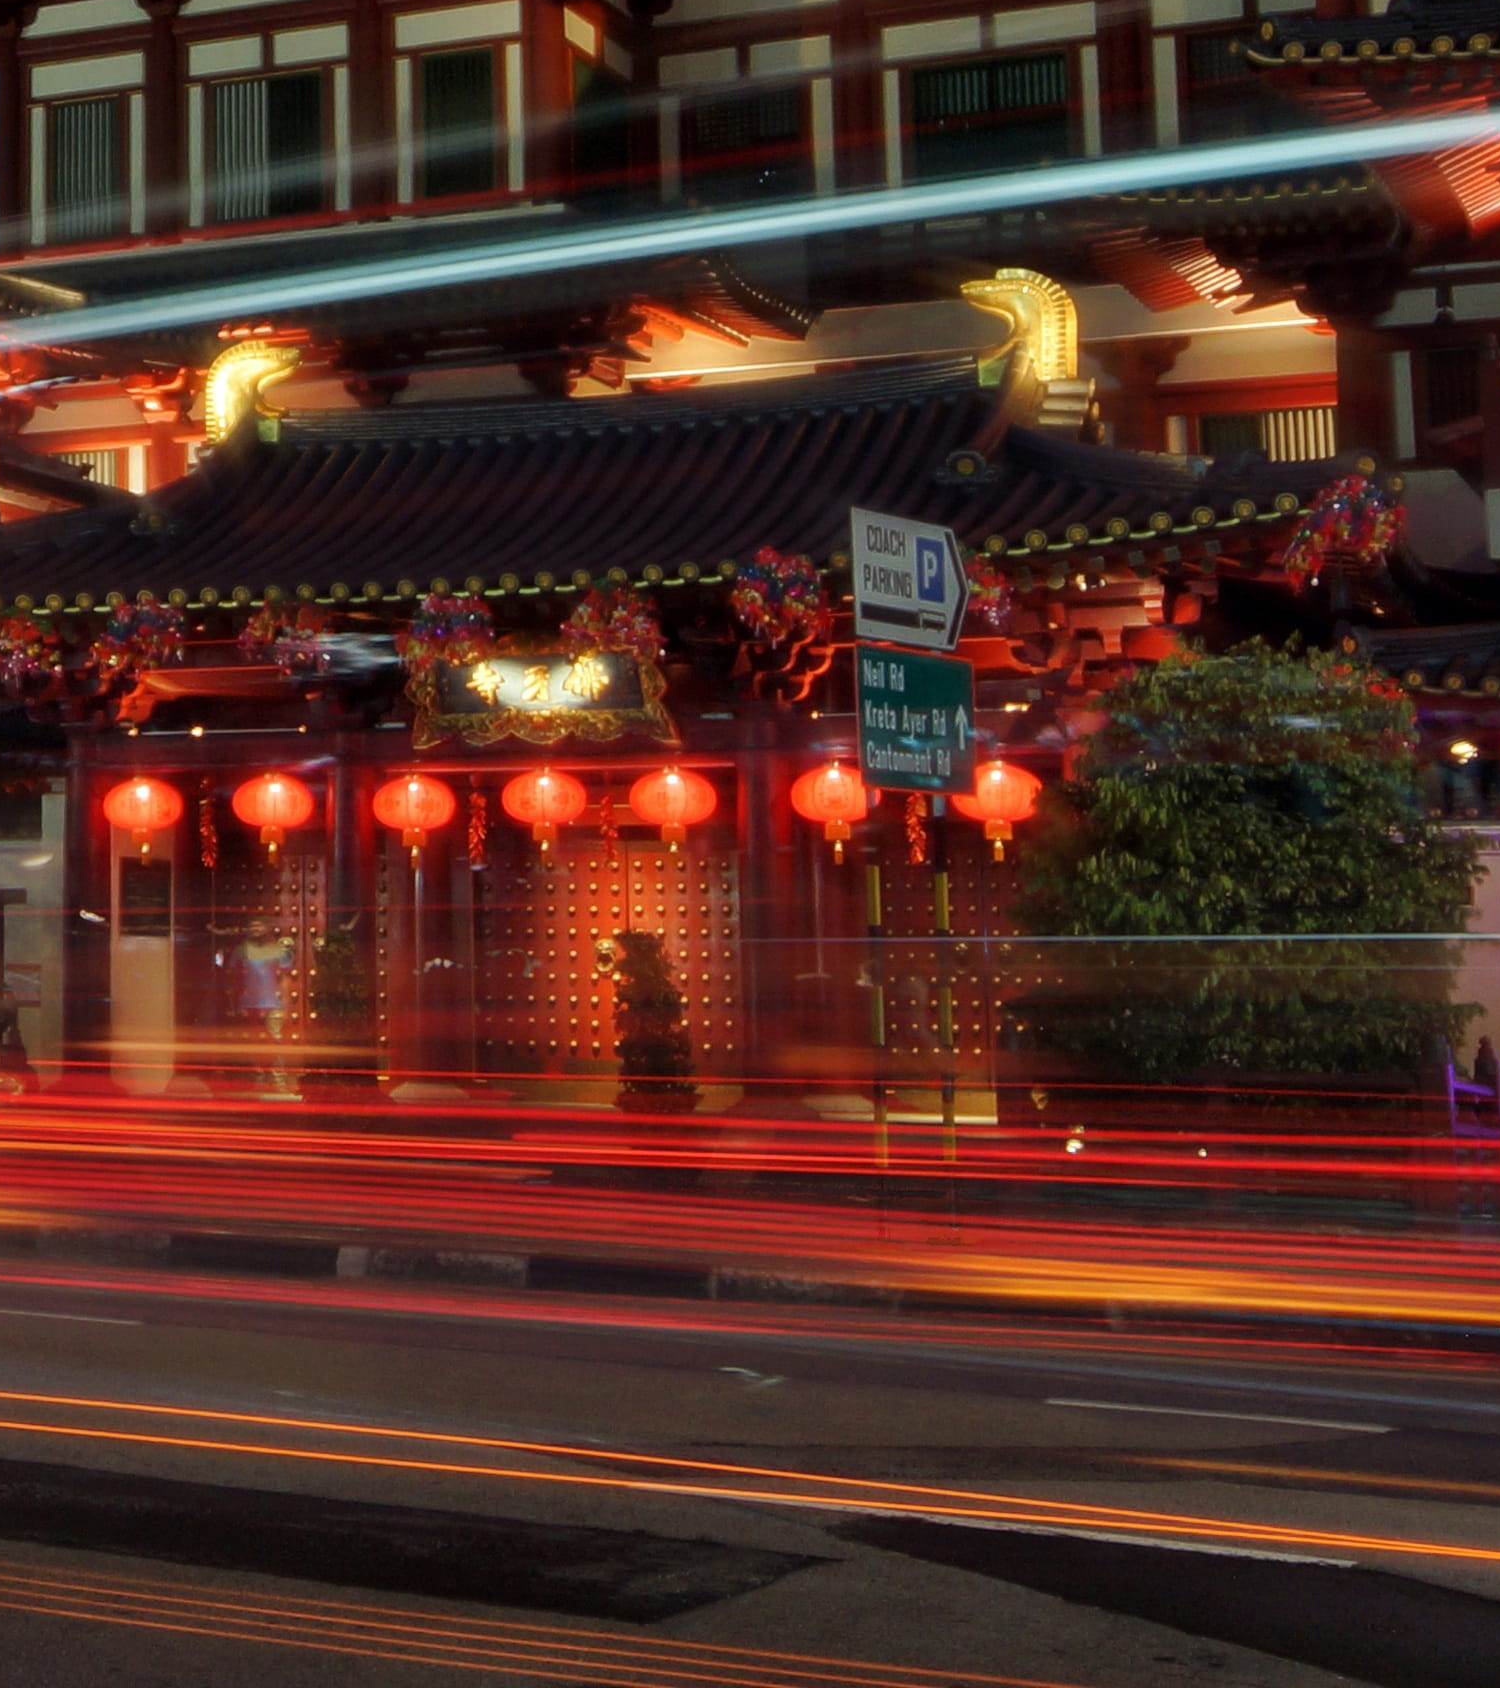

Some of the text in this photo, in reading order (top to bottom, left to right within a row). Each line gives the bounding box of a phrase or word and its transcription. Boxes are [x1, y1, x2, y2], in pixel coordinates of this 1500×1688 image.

[866, 524, 906, 558] COACH
[863, 563, 913, 599] PARKING
[923, 550, 938, 589] P
[863, 658, 905, 692] Neil Rd
[864, 698, 947, 739] Kreta Ayer Rd
[866, 740, 951, 777] Cantonment Rd
